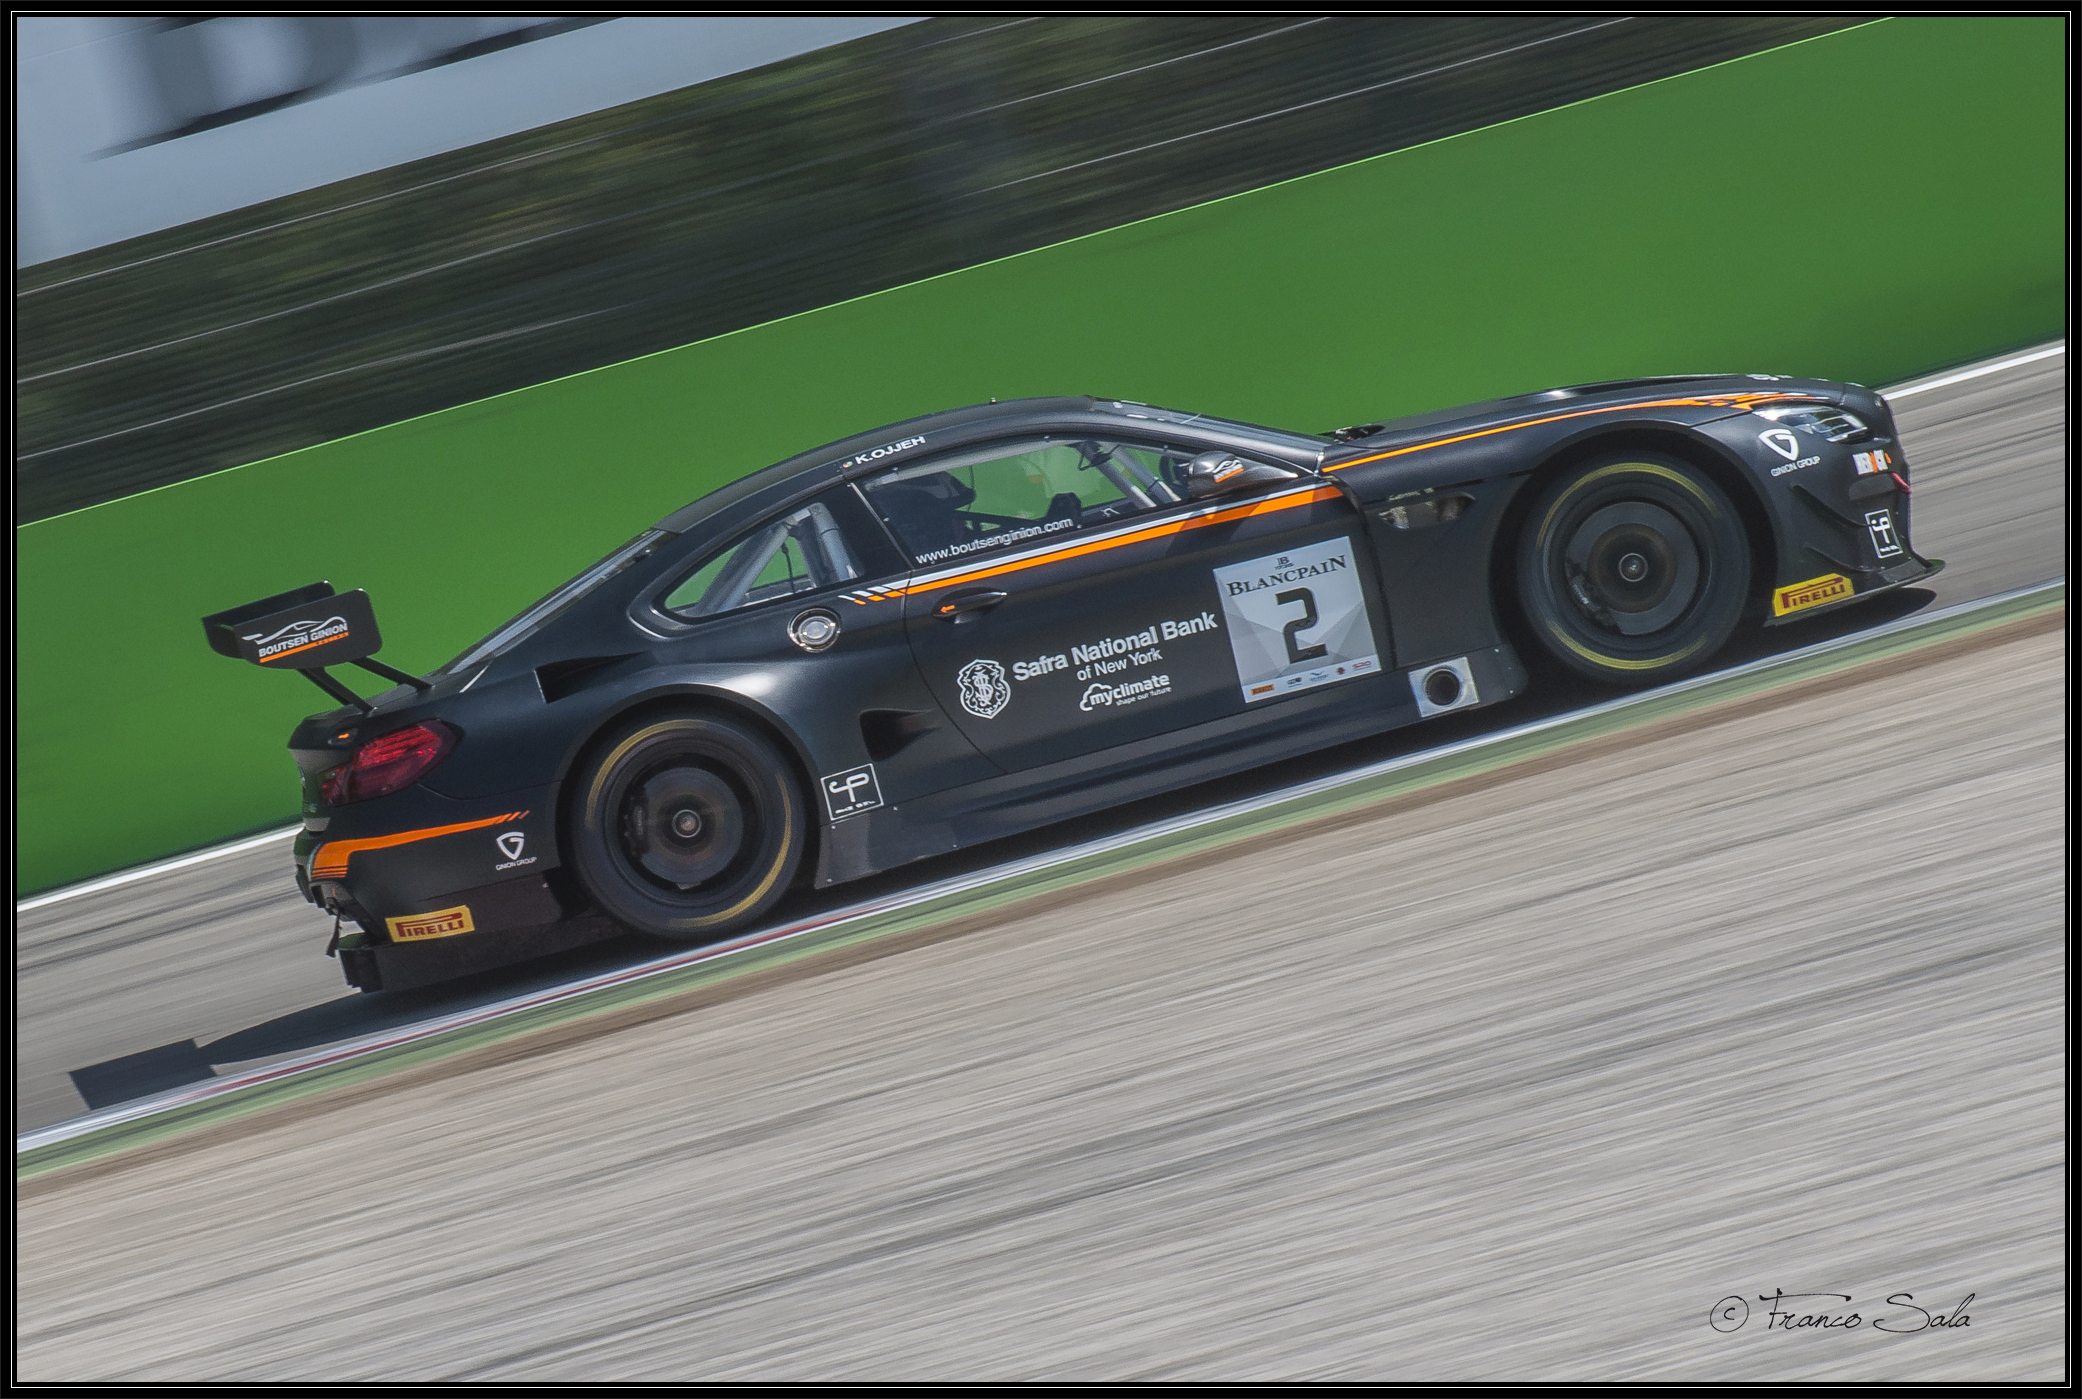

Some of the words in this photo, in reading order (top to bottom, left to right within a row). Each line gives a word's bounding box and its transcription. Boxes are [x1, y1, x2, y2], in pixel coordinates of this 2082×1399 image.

[855, 436, 926, 465] K.OJJEH
[915, 518, 1073, 564] www.boutsenginion.com
[1227, 555, 1347, 596] BLANCPAIN
[1781, 576, 1846, 609] PIRELLI
[258, 634, 309, 658] BOUTSEN
[310, 622, 348, 641] GINION
[1275, 587, 1328, 664] 2
[1012, 654, 1069, 681] Safra
[1070, 626, 1159, 666] National
[1160, 611, 1219, 642] Bank
[1076, 665, 1092, 681] of
[1093, 657, 1127, 677] New
[1128, 648, 1163, 668] York
[1089, 674, 1171, 706] myclimate
[395, 911, 465, 938] PIRELLI
